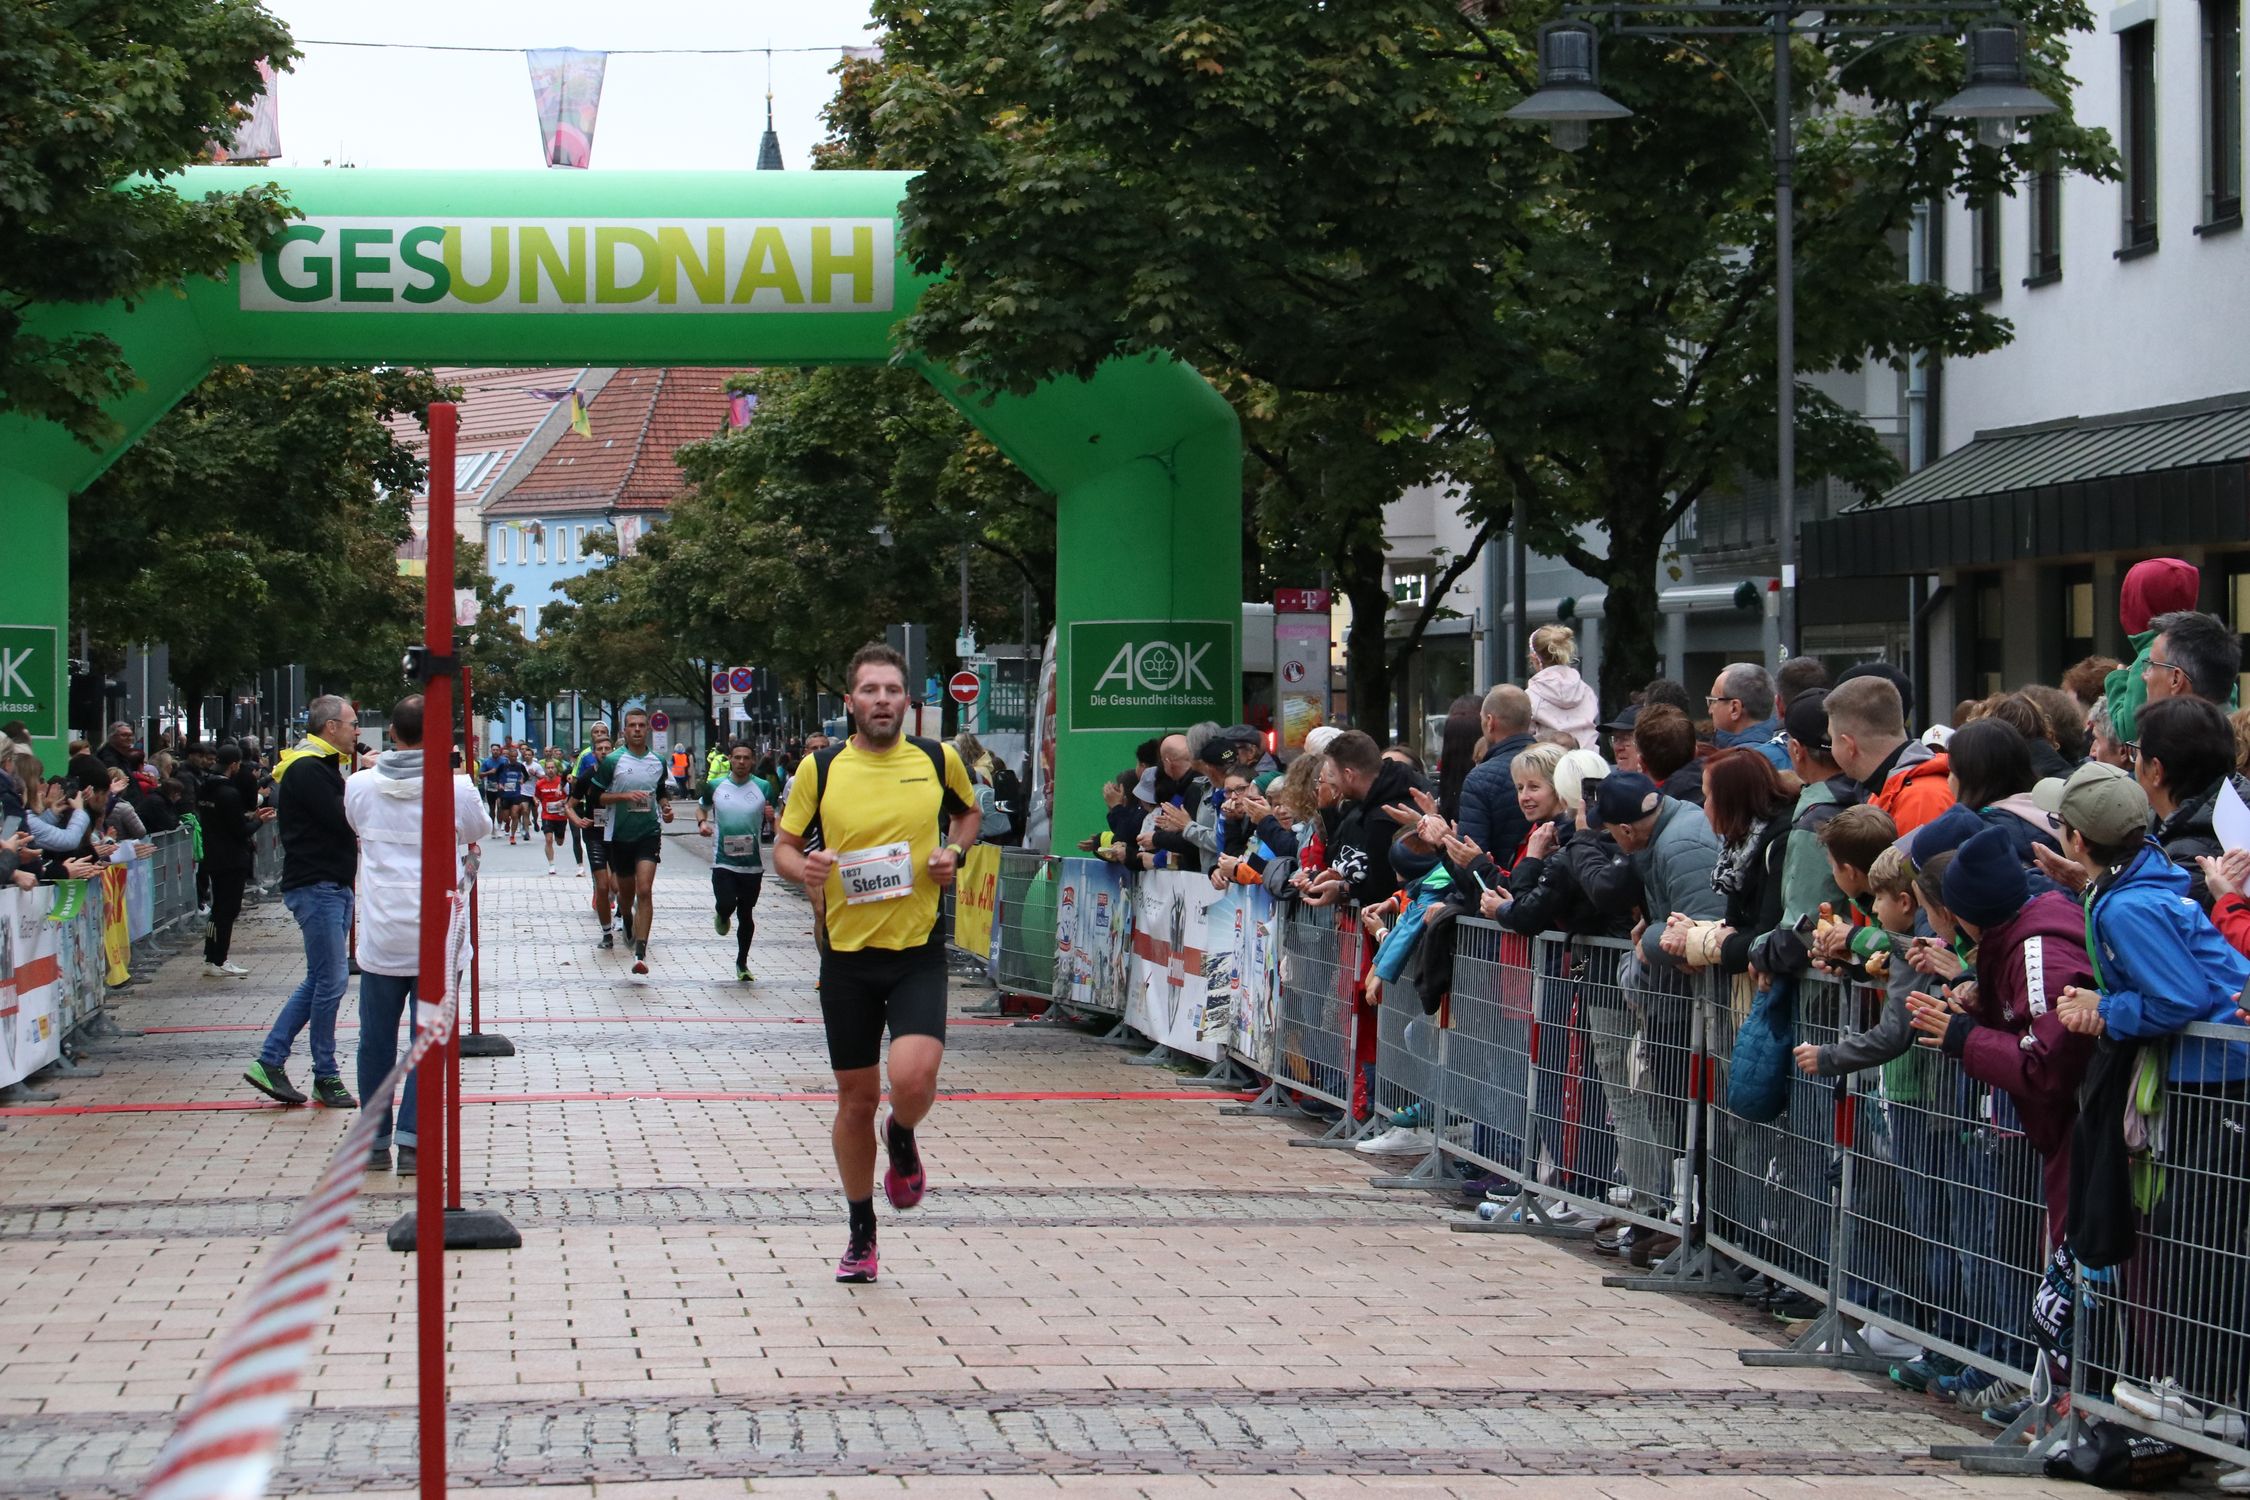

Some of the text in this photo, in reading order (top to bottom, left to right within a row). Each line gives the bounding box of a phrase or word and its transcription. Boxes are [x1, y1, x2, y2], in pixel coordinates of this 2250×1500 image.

[261, 225, 873, 304] GESUNDNAH
[0, 647, 35, 697] K
[1093, 641, 1214, 691] AOK
[1090, 694, 1107, 706] Die
[841, 868, 862, 878] 1837
[852, 874, 901, 893] Stefan
